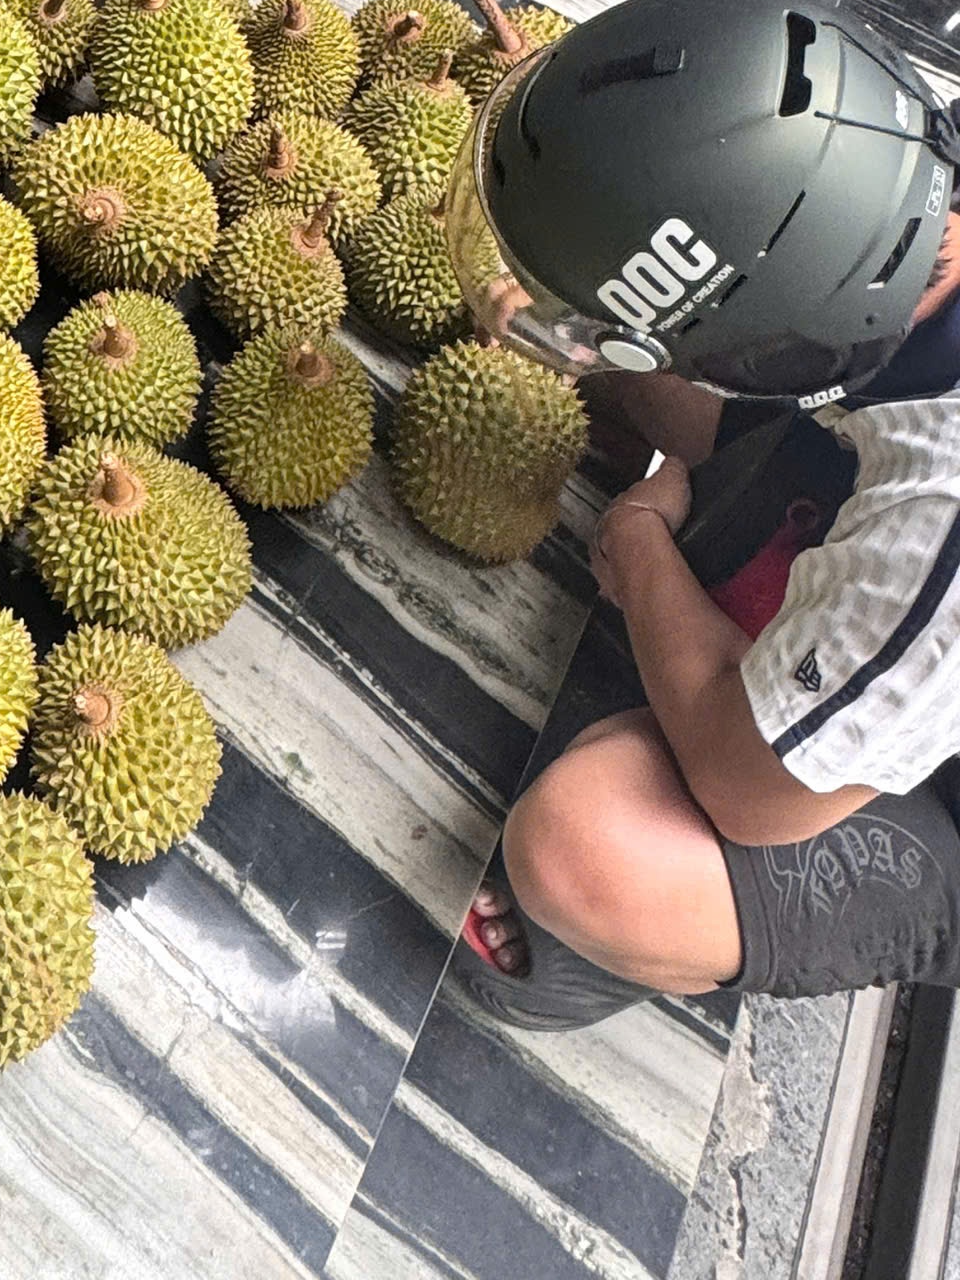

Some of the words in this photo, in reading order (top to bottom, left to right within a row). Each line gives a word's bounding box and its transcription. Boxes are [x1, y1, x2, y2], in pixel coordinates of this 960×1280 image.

[597, 218, 717, 334] POC
[656, 309, 687, 332] POWER
[681, 300, 695, 313] OF
[692, 263, 736, 303] CREATION
